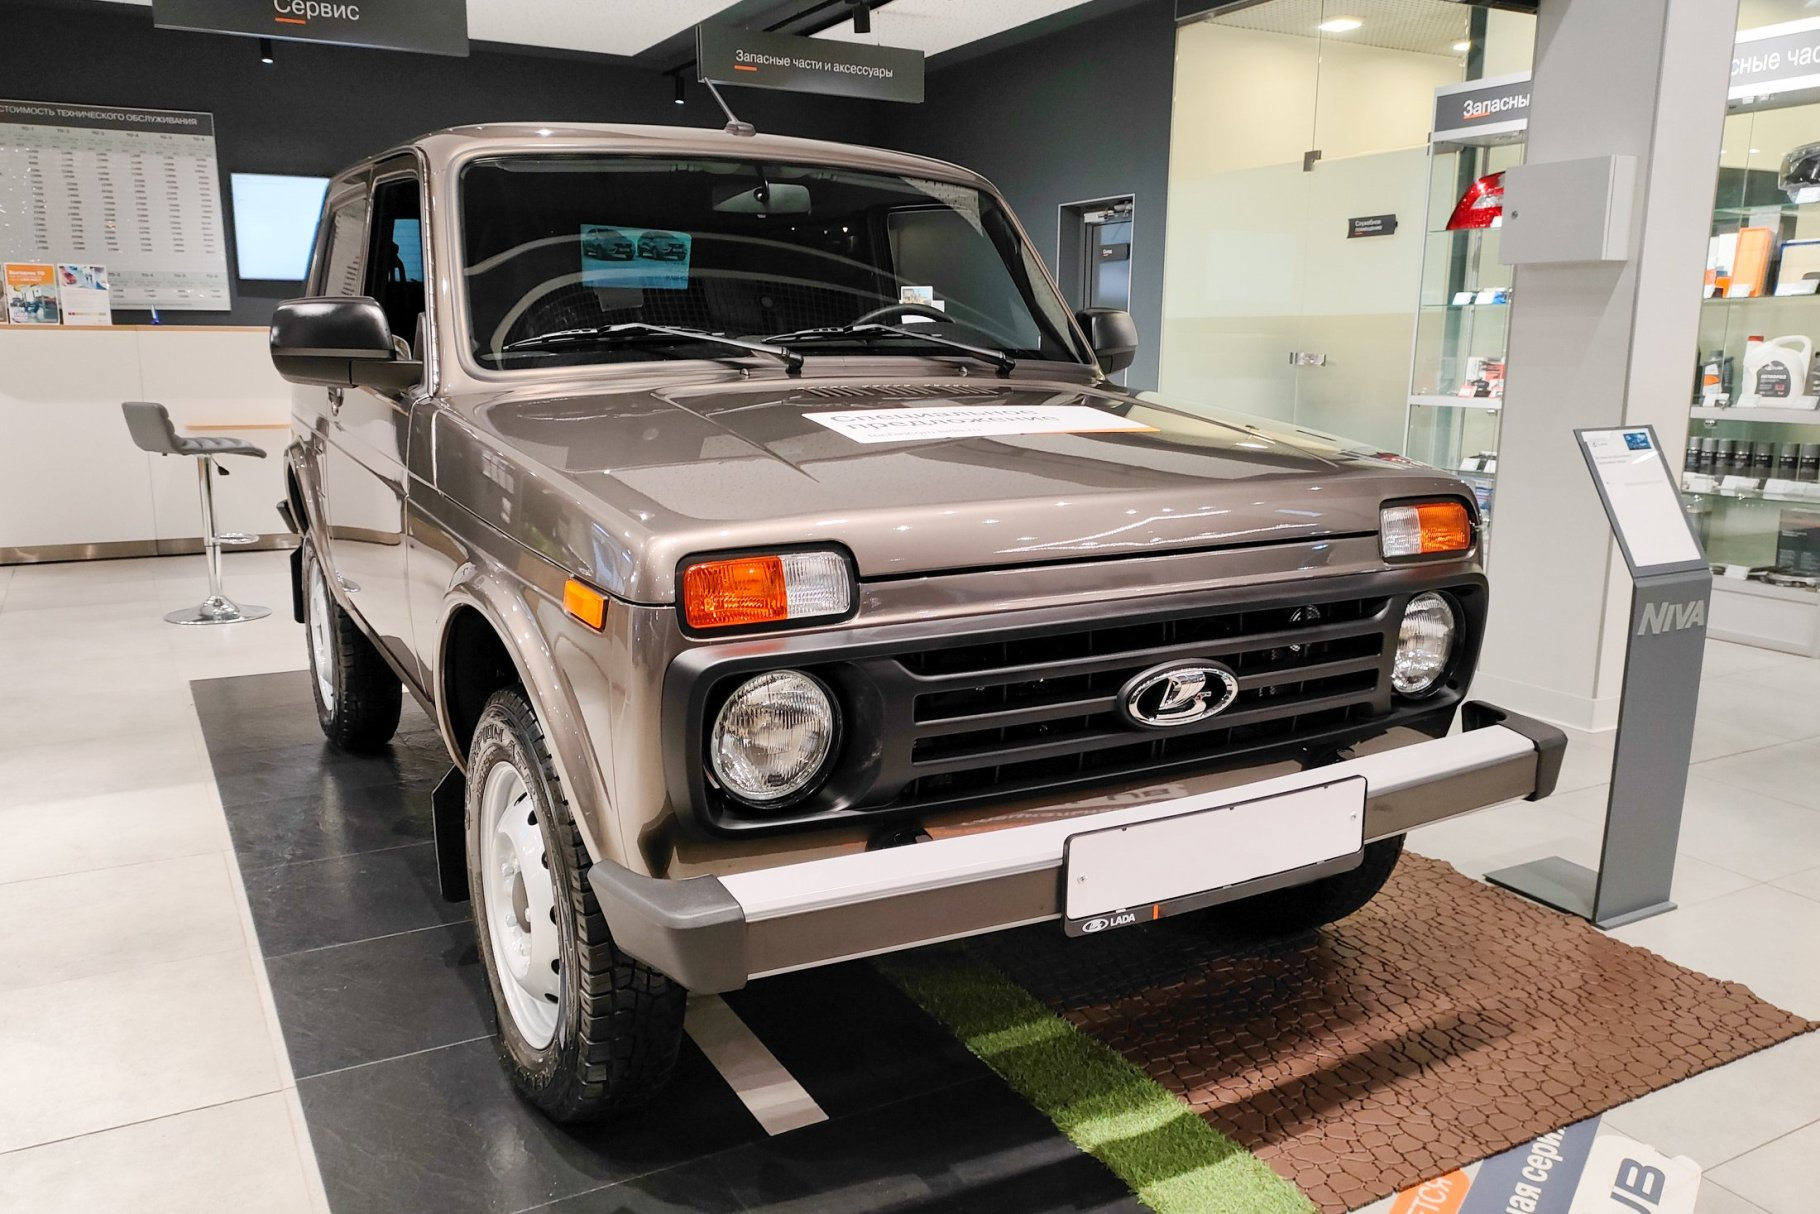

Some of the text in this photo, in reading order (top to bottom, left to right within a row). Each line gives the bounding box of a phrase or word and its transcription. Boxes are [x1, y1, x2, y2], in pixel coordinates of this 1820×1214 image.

[273, 0, 360, 21] Сервис
[735, 49, 894, 79] Запасные части и аксессуары
[0, 105, 198, 126] СТОИМОСТЬ ТЕХНИЧЕСКОГО ОБСЛУЖИВАНИЯ
[830, 410, 1038, 422] Специальное
[847, 416, 1060, 430] предложение
[1637, 600, 1704, 636] NIVA
[1110, 913, 1136, 927] LADA
[1522, 1127, 1567, 1182] сери
